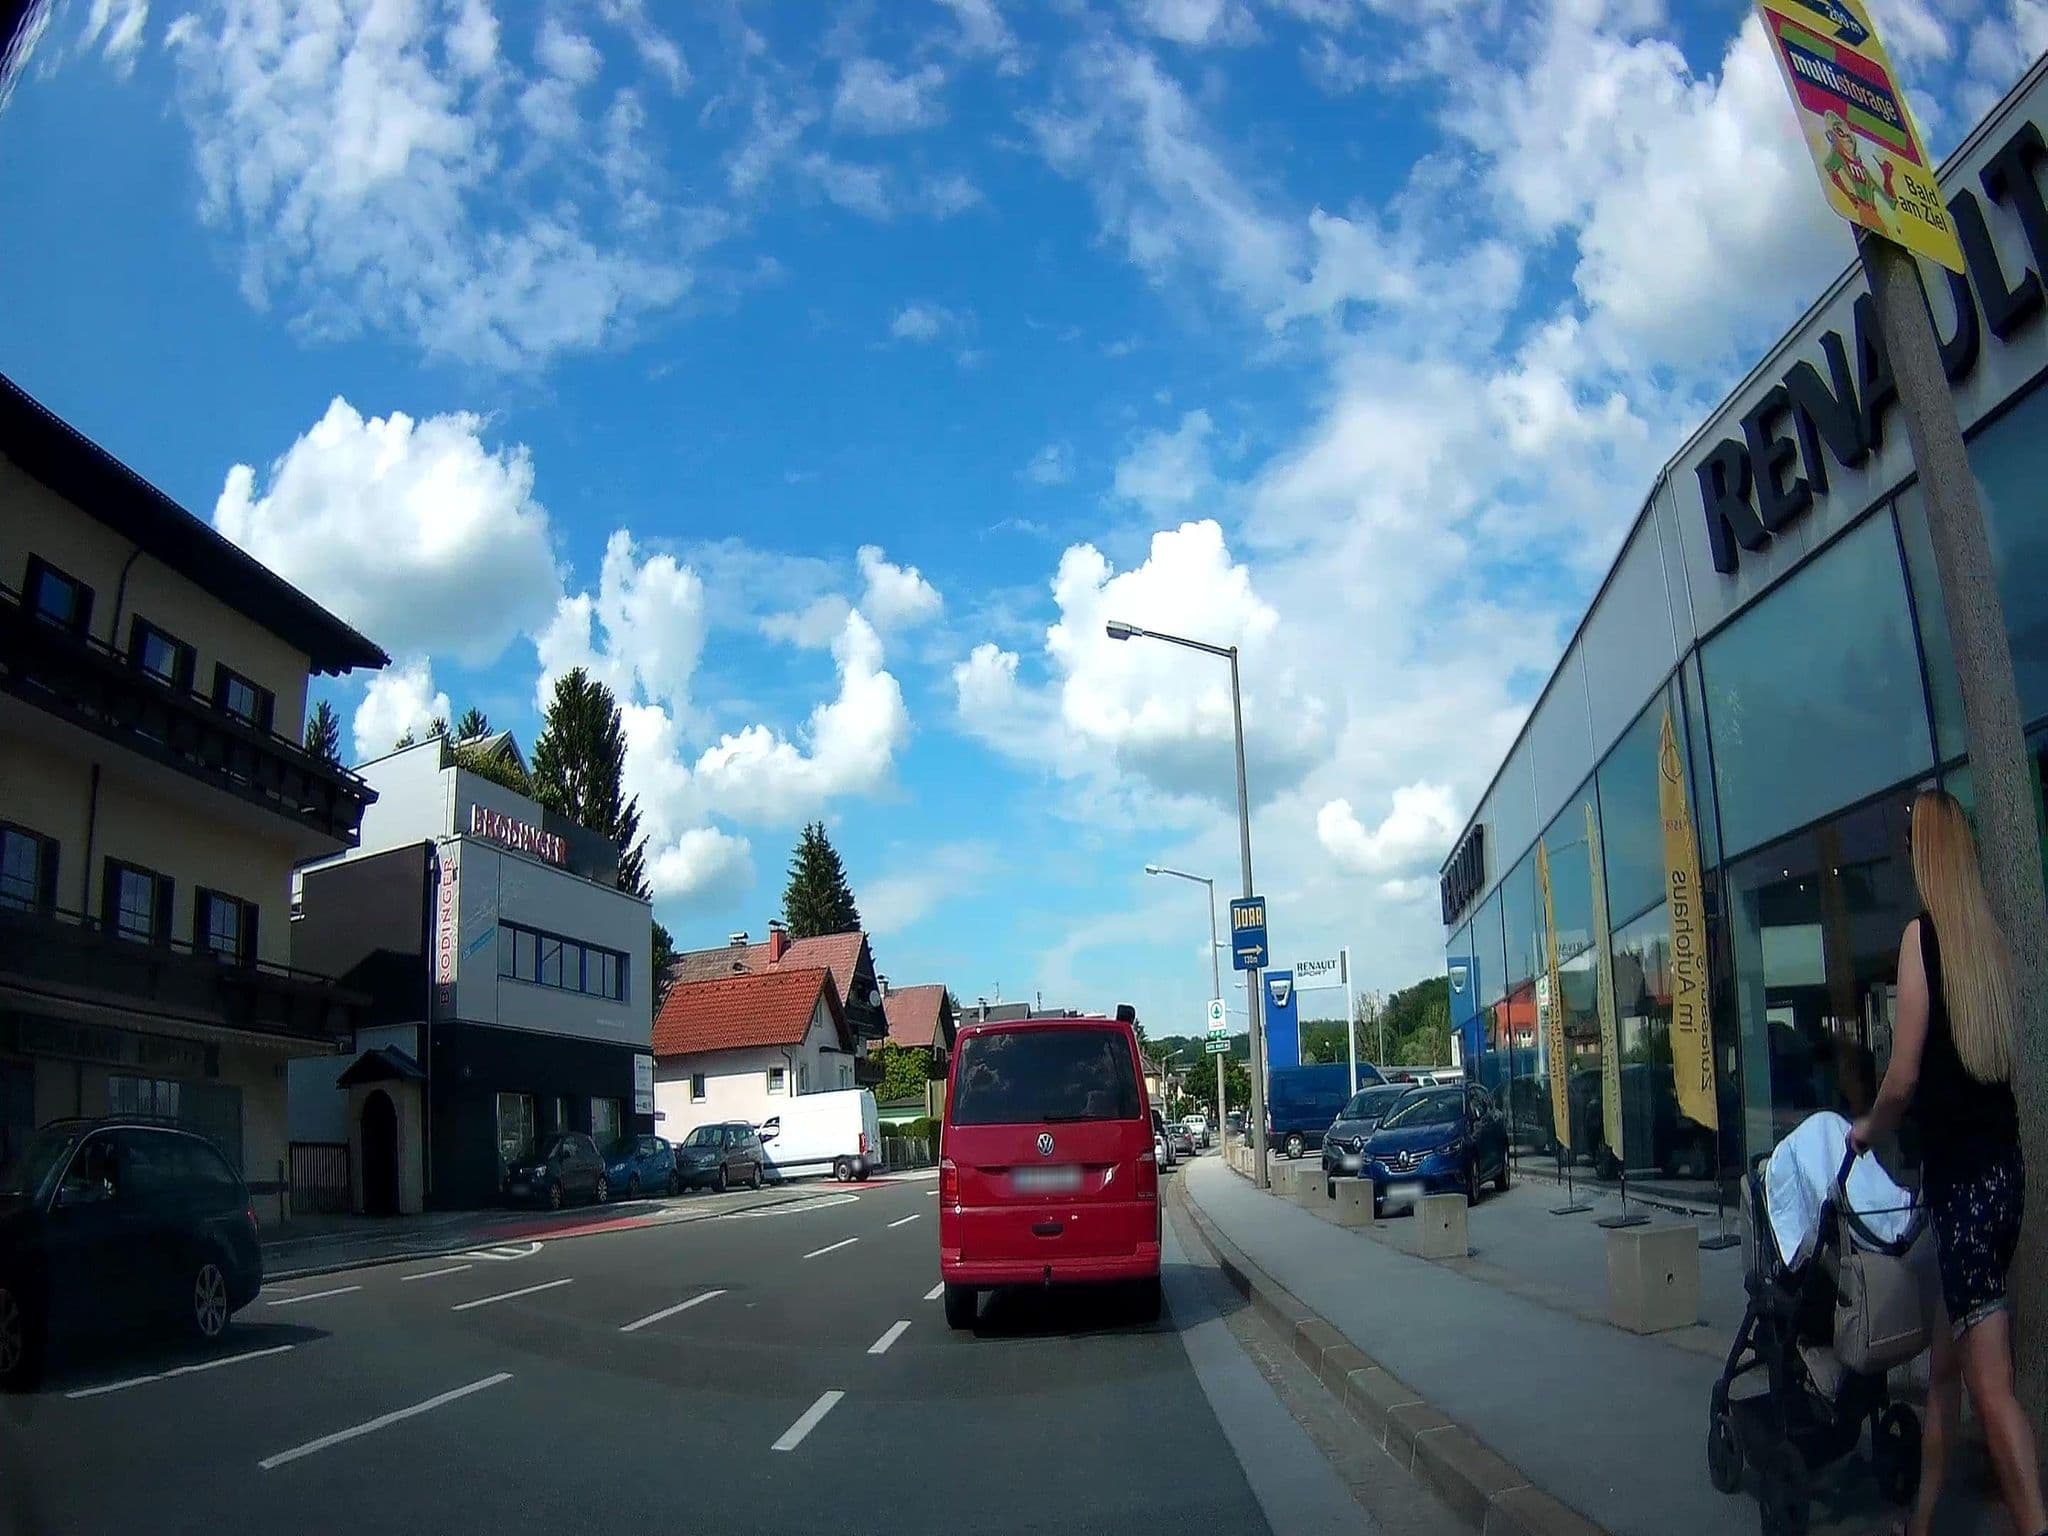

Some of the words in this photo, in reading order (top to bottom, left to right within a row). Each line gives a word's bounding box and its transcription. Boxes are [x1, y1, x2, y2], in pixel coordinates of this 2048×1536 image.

[1788, 49, 1897, 122] multistorage
[1903, 174, 1939, 208] Bald
[1899, 196, 1920, 220] am
[1919, 204, 1949, 234] Ziel
[440, 857, 453, 1004] BRODINGER
[1296, 959, 1337, 972] RENAULT
